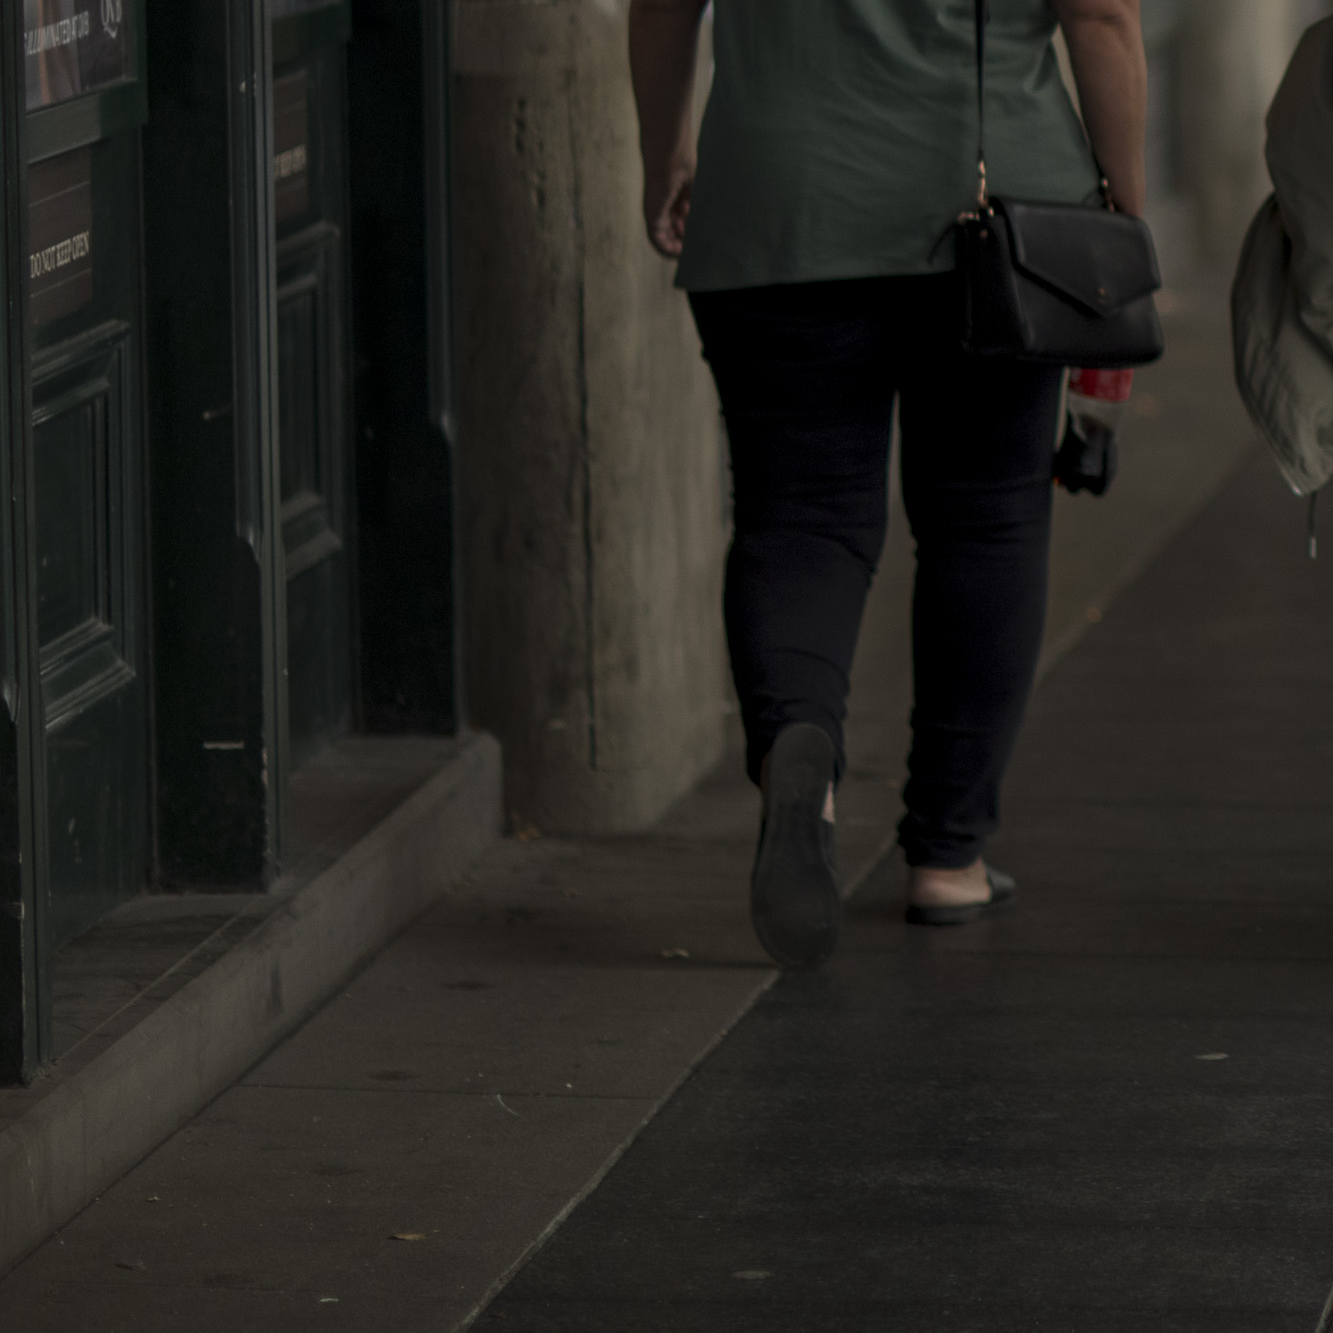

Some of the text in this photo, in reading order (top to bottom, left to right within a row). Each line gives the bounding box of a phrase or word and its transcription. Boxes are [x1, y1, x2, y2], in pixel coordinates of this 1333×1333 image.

[30, 231, 89, 279] DO NOT KEEP OPEN
